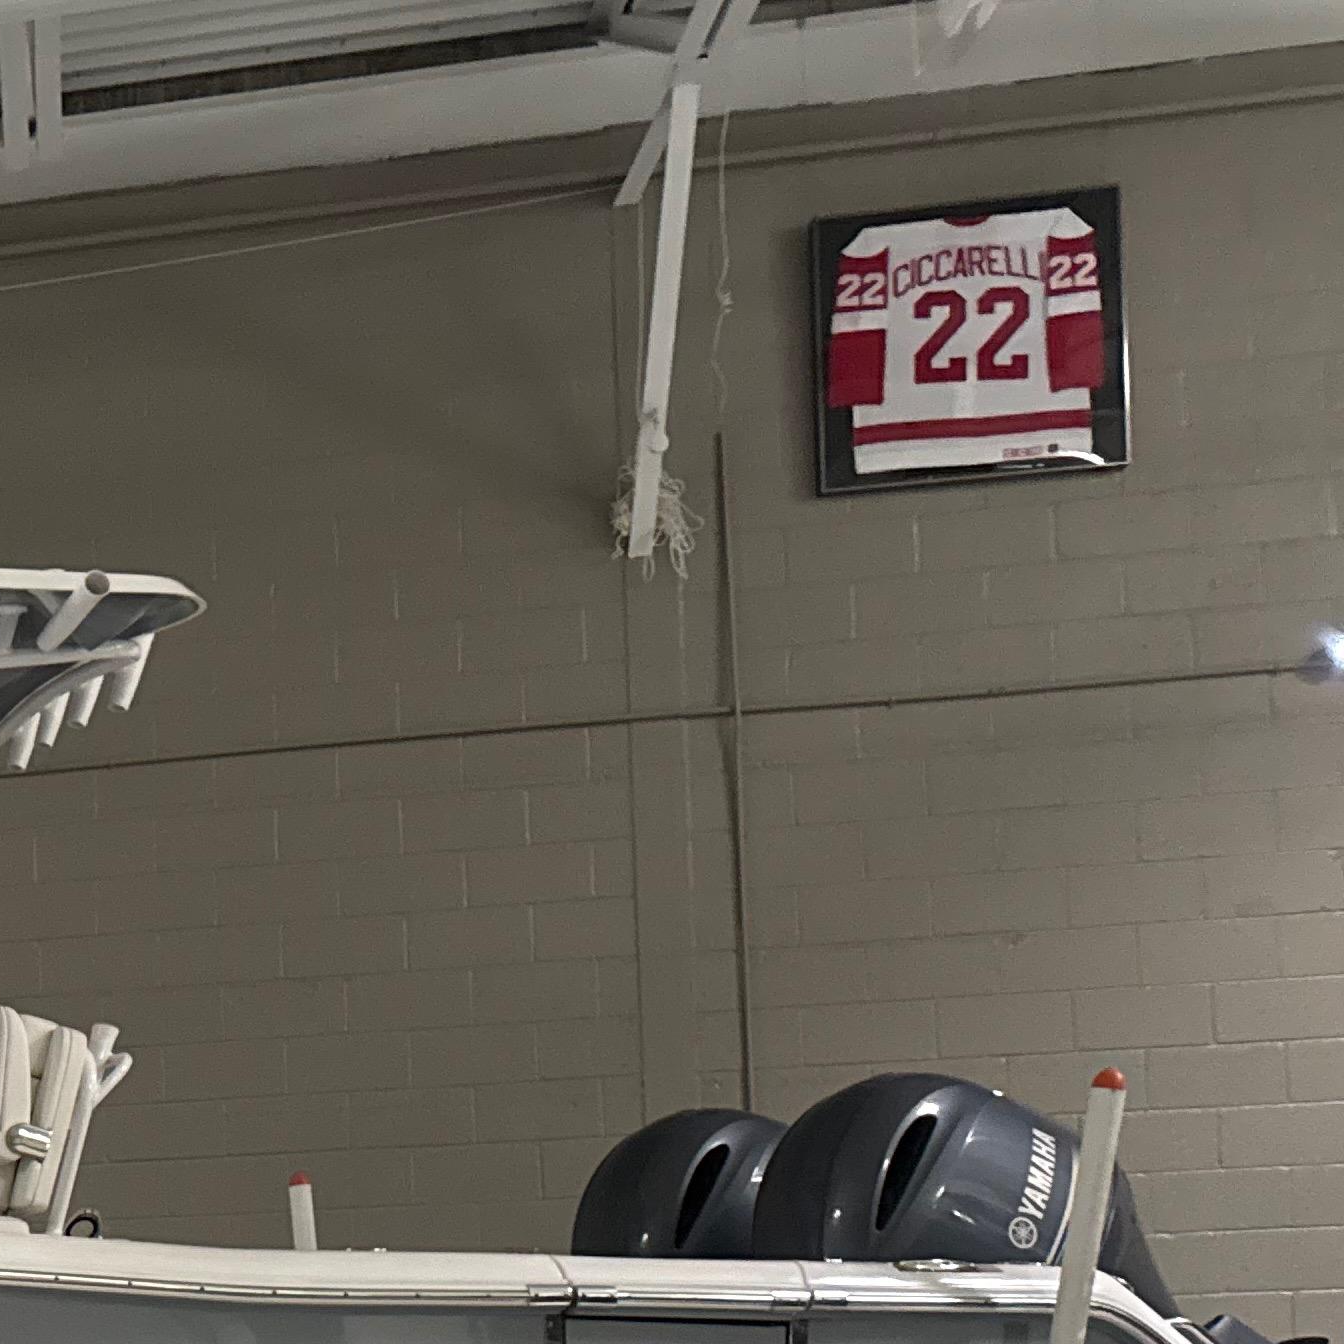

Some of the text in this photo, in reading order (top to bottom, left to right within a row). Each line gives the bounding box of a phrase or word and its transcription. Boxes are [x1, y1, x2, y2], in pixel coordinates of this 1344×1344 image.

[835, 273, 886, 307] 22
[1048, 252, 1098, 291] 22
[913, 285, 1031, 385] 22
[1017, 1127, 1056, 1221] YAMAHA
